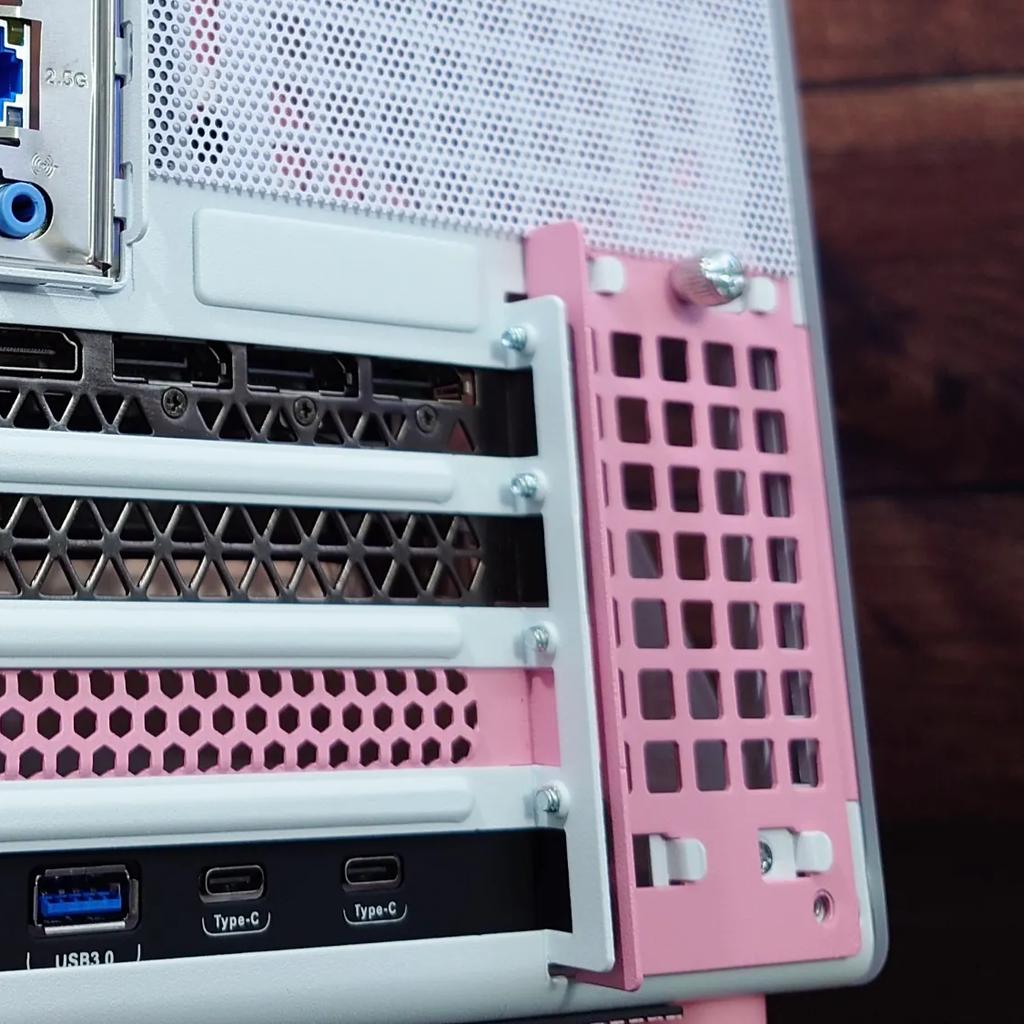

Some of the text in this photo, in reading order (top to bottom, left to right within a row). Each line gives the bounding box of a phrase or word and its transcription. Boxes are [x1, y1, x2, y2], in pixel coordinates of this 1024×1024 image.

[45, 67, 88, 88] 2.5G
[355, 901, 397, 920] Type-C
[213, 911, 260, 931] Type-C
[55, 950, 115, 968] USB30
